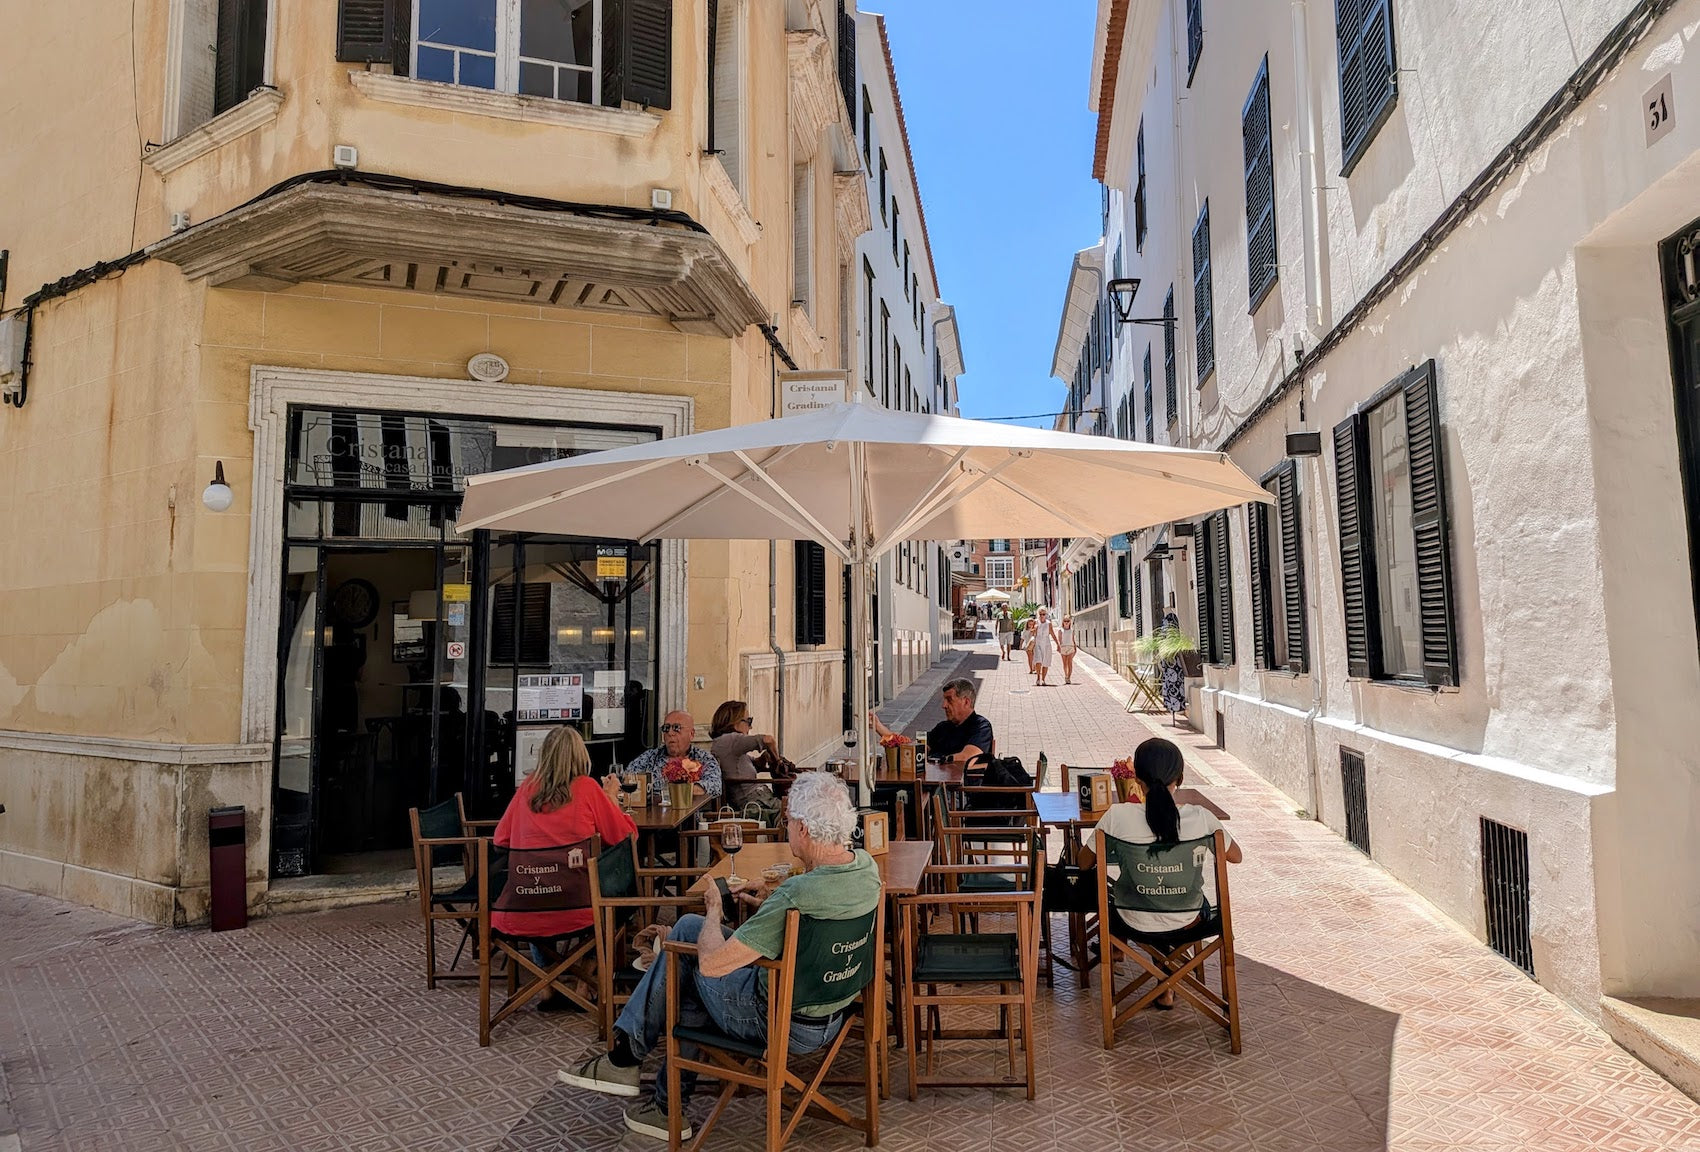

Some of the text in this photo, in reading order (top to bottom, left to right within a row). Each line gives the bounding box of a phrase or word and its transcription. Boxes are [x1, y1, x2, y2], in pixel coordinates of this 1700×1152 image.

[1648, 91, 1668, 131] 31
[789, 384, 837, 392] Cristanal
[787, 401, 830, 410] Gradin
[326, 435, 437, 461] Cristanal
[385, 462, 417, 474] casa
[515, 863, 559, 875] Cristanal
[1136, 862, 1184, 874] Cristanal
[534, 875, 541, 885] y
[1157, 875, 1164, 885] y
[515, 884, 563, 895] Gradinata
[1136, 884, 1187, 895] Gradinata
[845, 953, 854, 966] y
